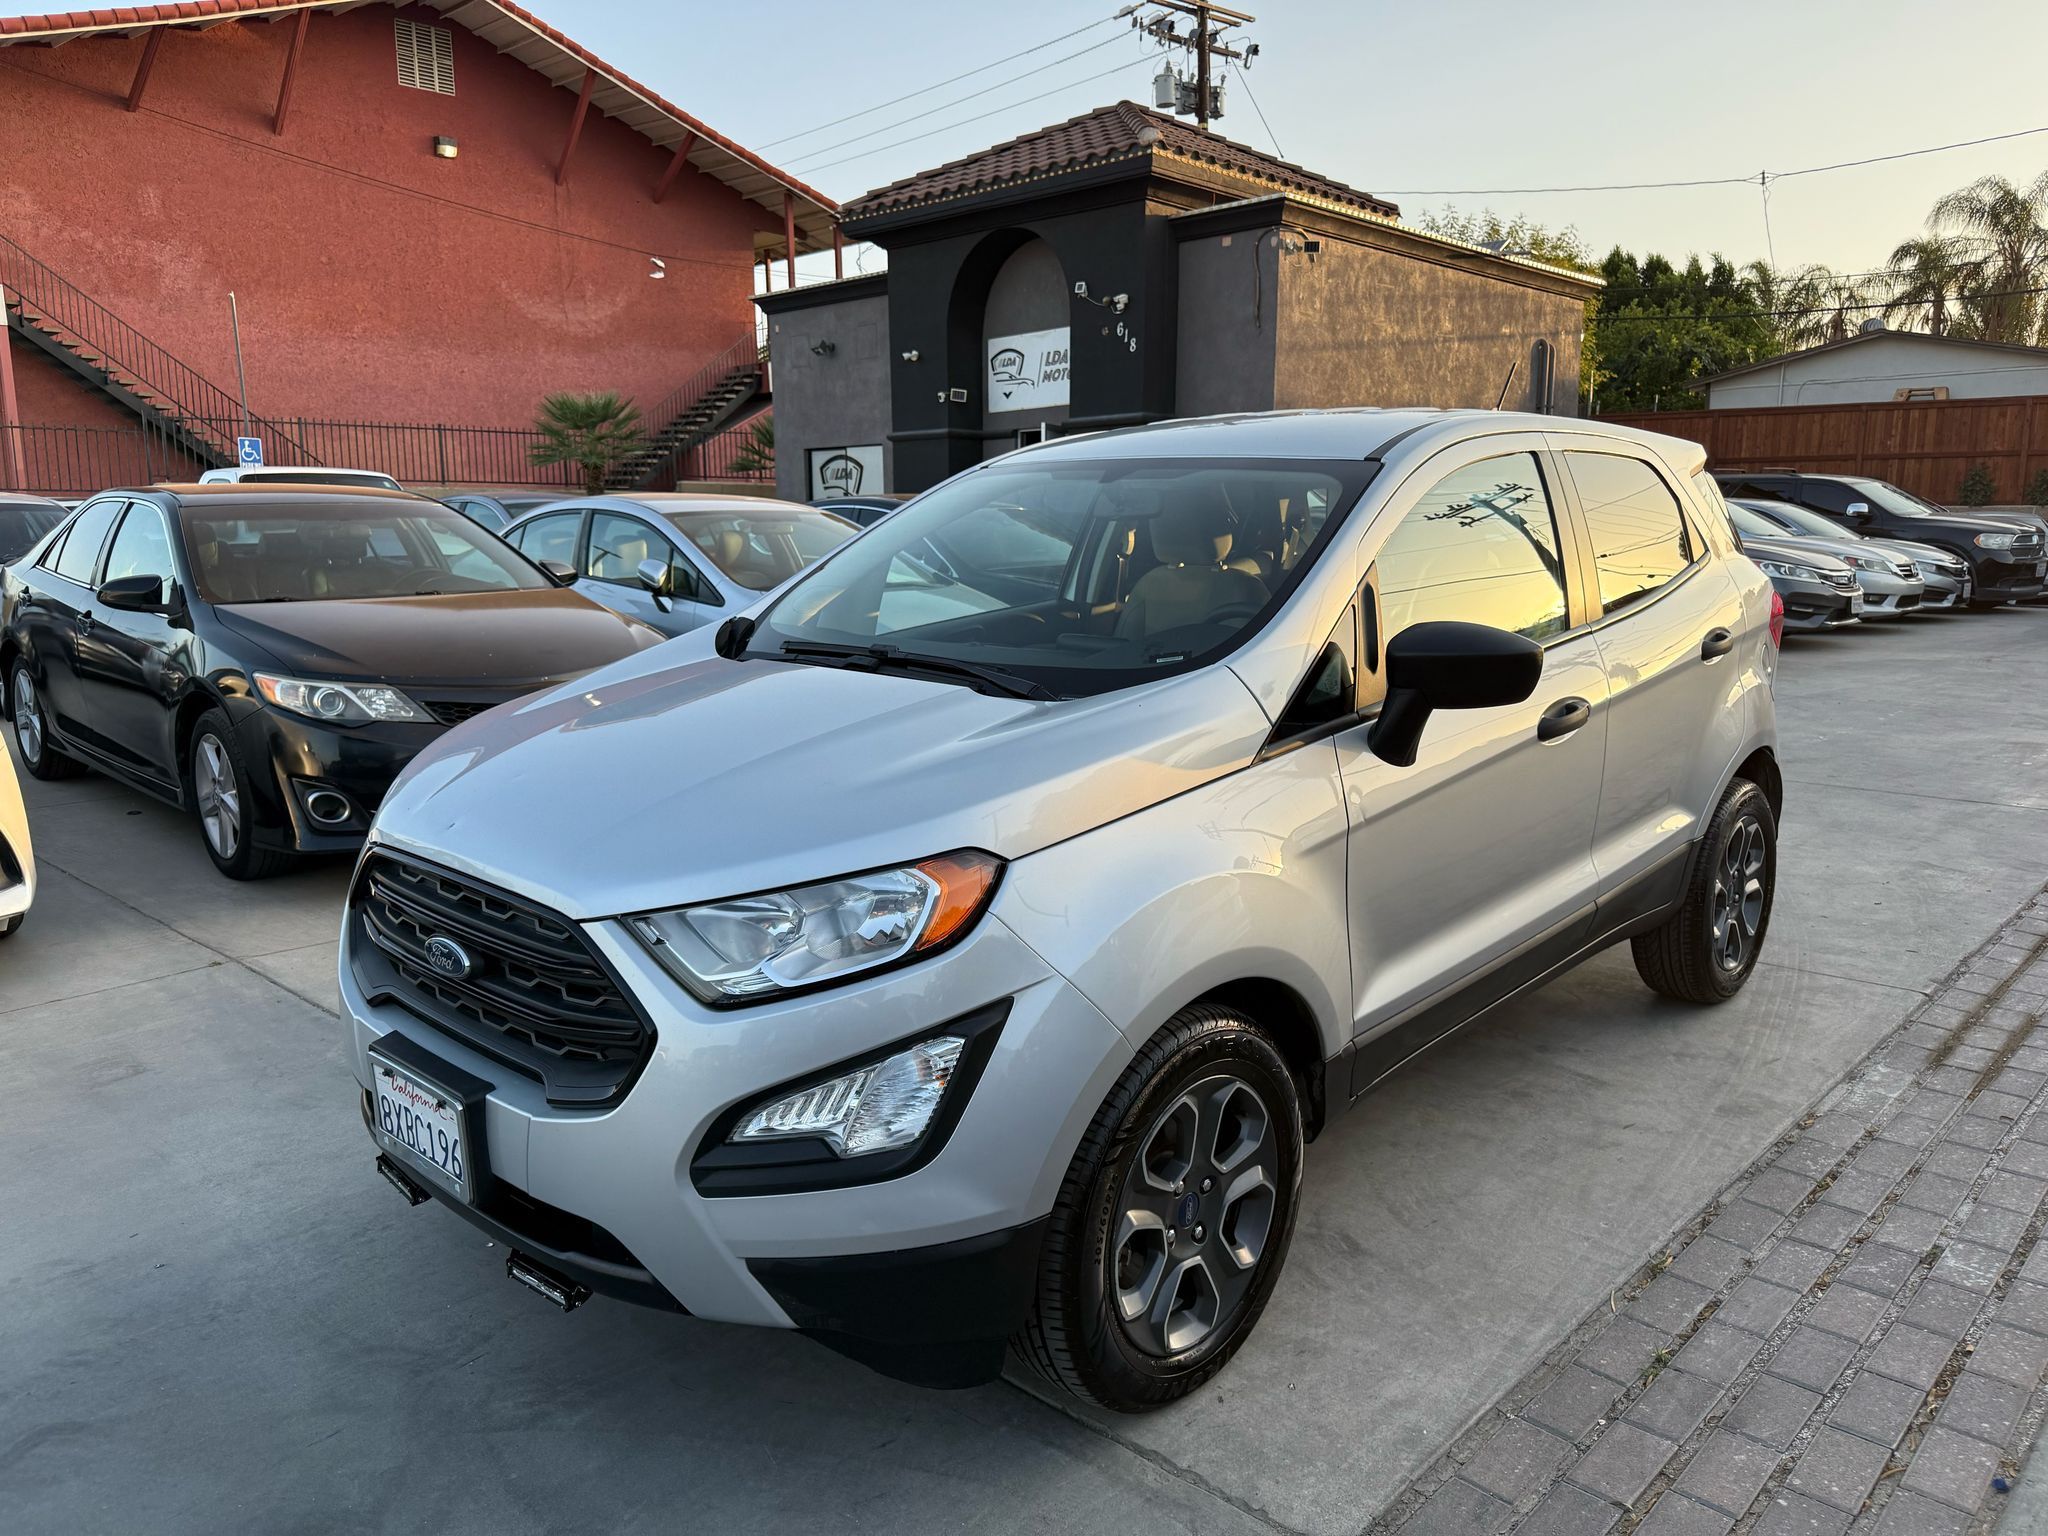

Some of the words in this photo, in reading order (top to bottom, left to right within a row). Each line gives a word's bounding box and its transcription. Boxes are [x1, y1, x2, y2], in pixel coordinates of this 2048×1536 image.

[1116, 322, 1136, 352] 618
[1045, 349, 1068, 366] LDA
[430, 943, 454, 970] Ford
[390, 1073, 446, 1118] California
[380, 1094, 462, 1181] 8XBC196
